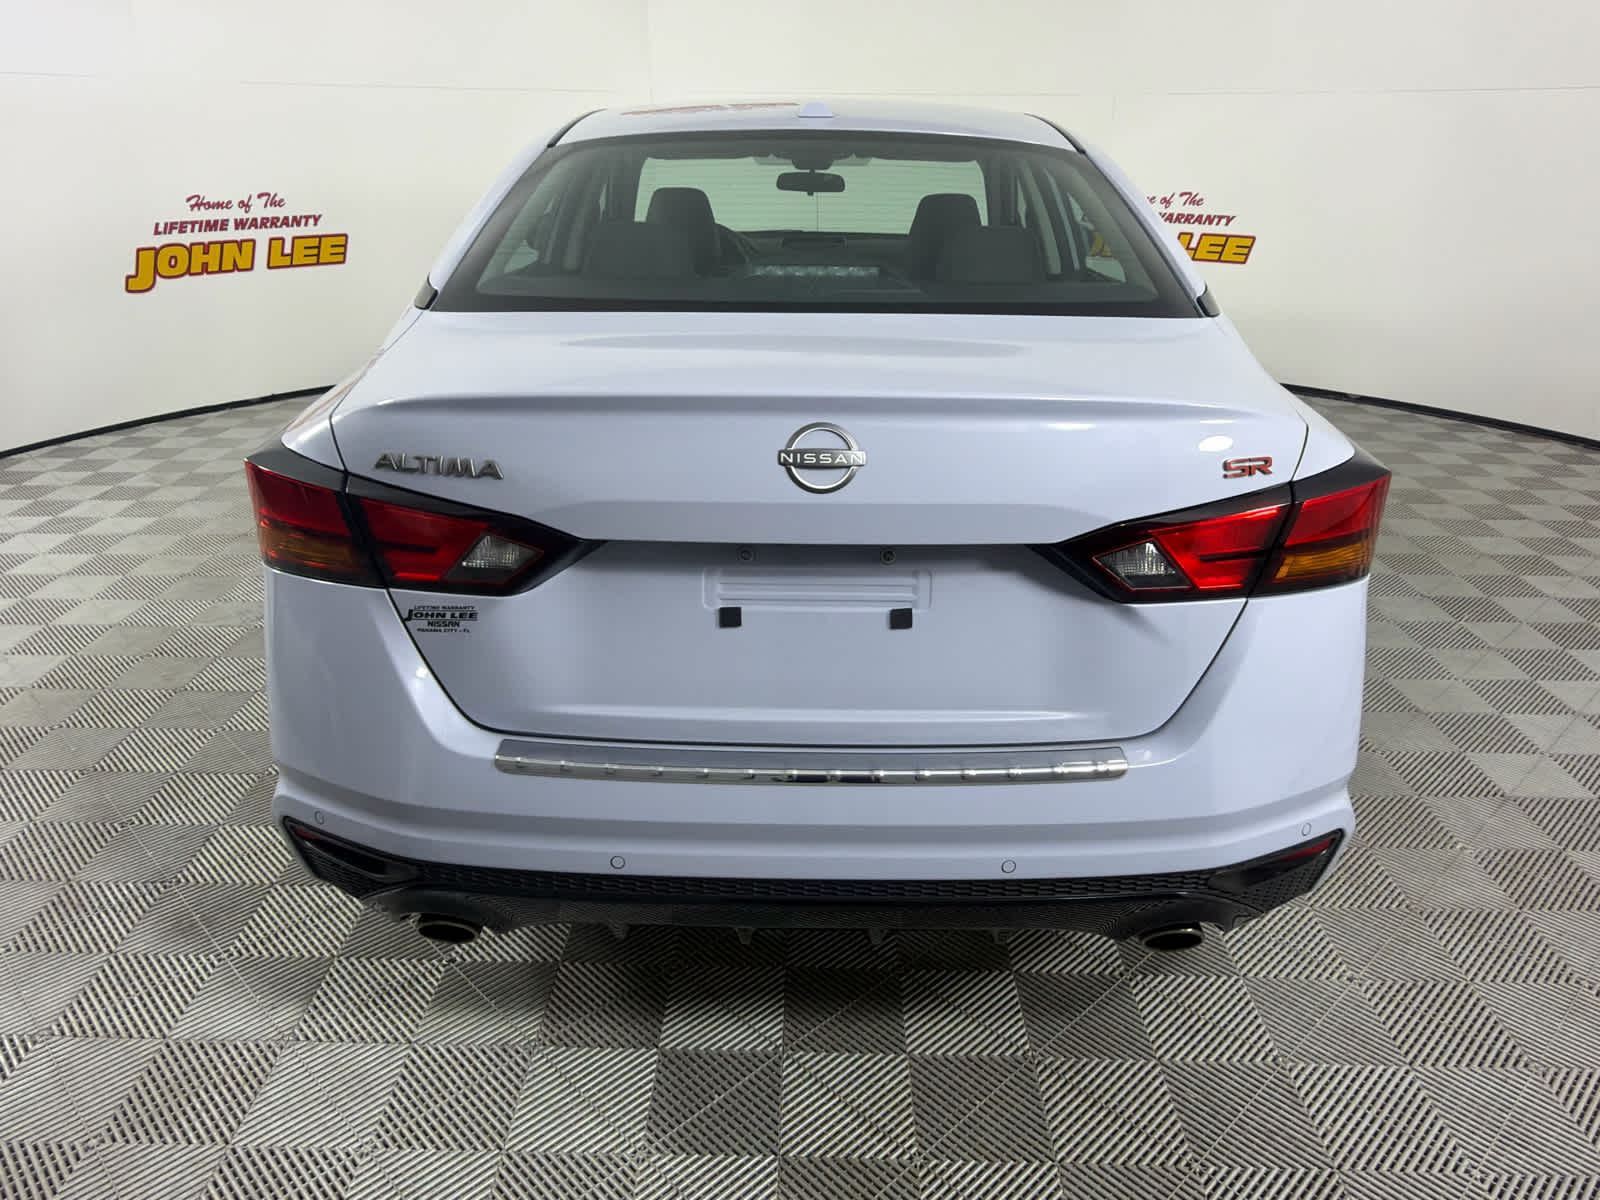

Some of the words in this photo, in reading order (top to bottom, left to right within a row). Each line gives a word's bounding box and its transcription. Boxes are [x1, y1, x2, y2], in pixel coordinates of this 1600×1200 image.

[186, 194, 233, 212] Home
[238, 194, 252, 214] of
[257, 192, 286, 209] The
[1160, 192, 1176, 209] of
[1179, 191, 1205, 207] The
[153, 218, 230, 236] LIFETIME
[233, 214, 322, 231] WARRANTY
[125, 239, 256, 293] JOHN
[266, 233, 348, 269] LEE
[374, 452, 504, 480] ALTIMA
[780, 452, 863, 464] NISSAN
[1222, 456, 1273, 479] SR
[403, 609, 447, 621] JOHN
